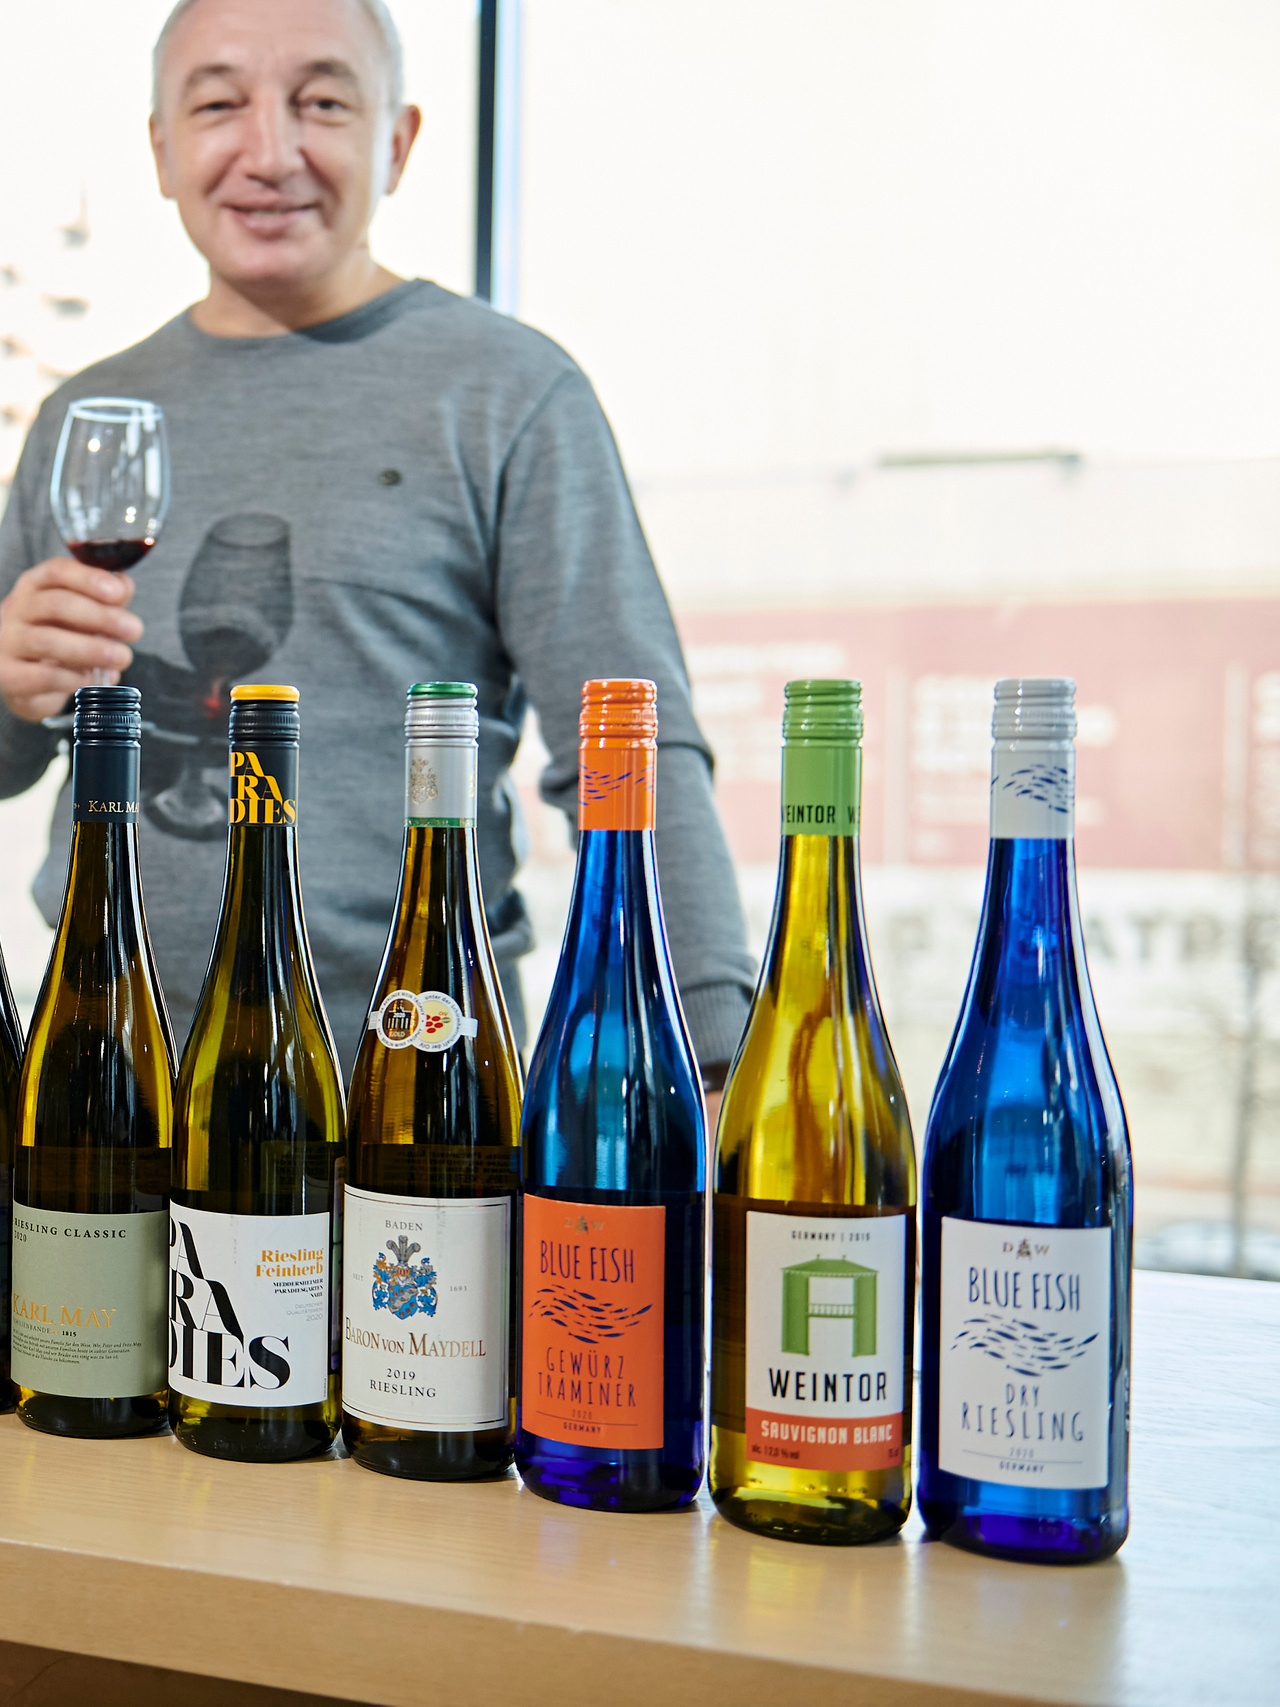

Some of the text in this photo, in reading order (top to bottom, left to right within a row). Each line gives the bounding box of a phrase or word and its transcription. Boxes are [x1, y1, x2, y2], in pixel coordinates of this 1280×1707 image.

[88, 800, 124, 813] KARL
[783, 804, 836, 824] EINTOR
[14, 1217, 127, 1239] RIESLING CLASSIC
[385, 1219, 424, 1231] BADEN
[791, 1230, 836, 1242] GERMANY
[262, 1248, 324, 1263] Riesling
[540, 1239, 635, 1284] BLUE FISH
[256, 1261, 324, 1277] Feinherb
[969, 1266, 1081, 1312] BLUE FISH
[13, 1293, 117, 1328] KARL MAY
[345, 1317, 380, 1350] BARON
[408, 1332, 487, 1358] MAYDELL
[546, 1346, 625, 1380] GEWÜRZ
[386, 1368, 416, 1381] 2019
[769, 1367, 888, 1403] WEINTOR
[370, 1379, 437, 1398] RIESLING
[537, 1372, 637, 1408] TRAMINER
[1005, 1383, 1040, 1408] DRY
[562, 1421, 602, 1434] GERMANY
[761, 1419, 893, 1446] SAUVIGNON BLANC
[961, 1401, 1084, 1443] RIESLING
[998, 1461, 1045, 1474] GERMANY
